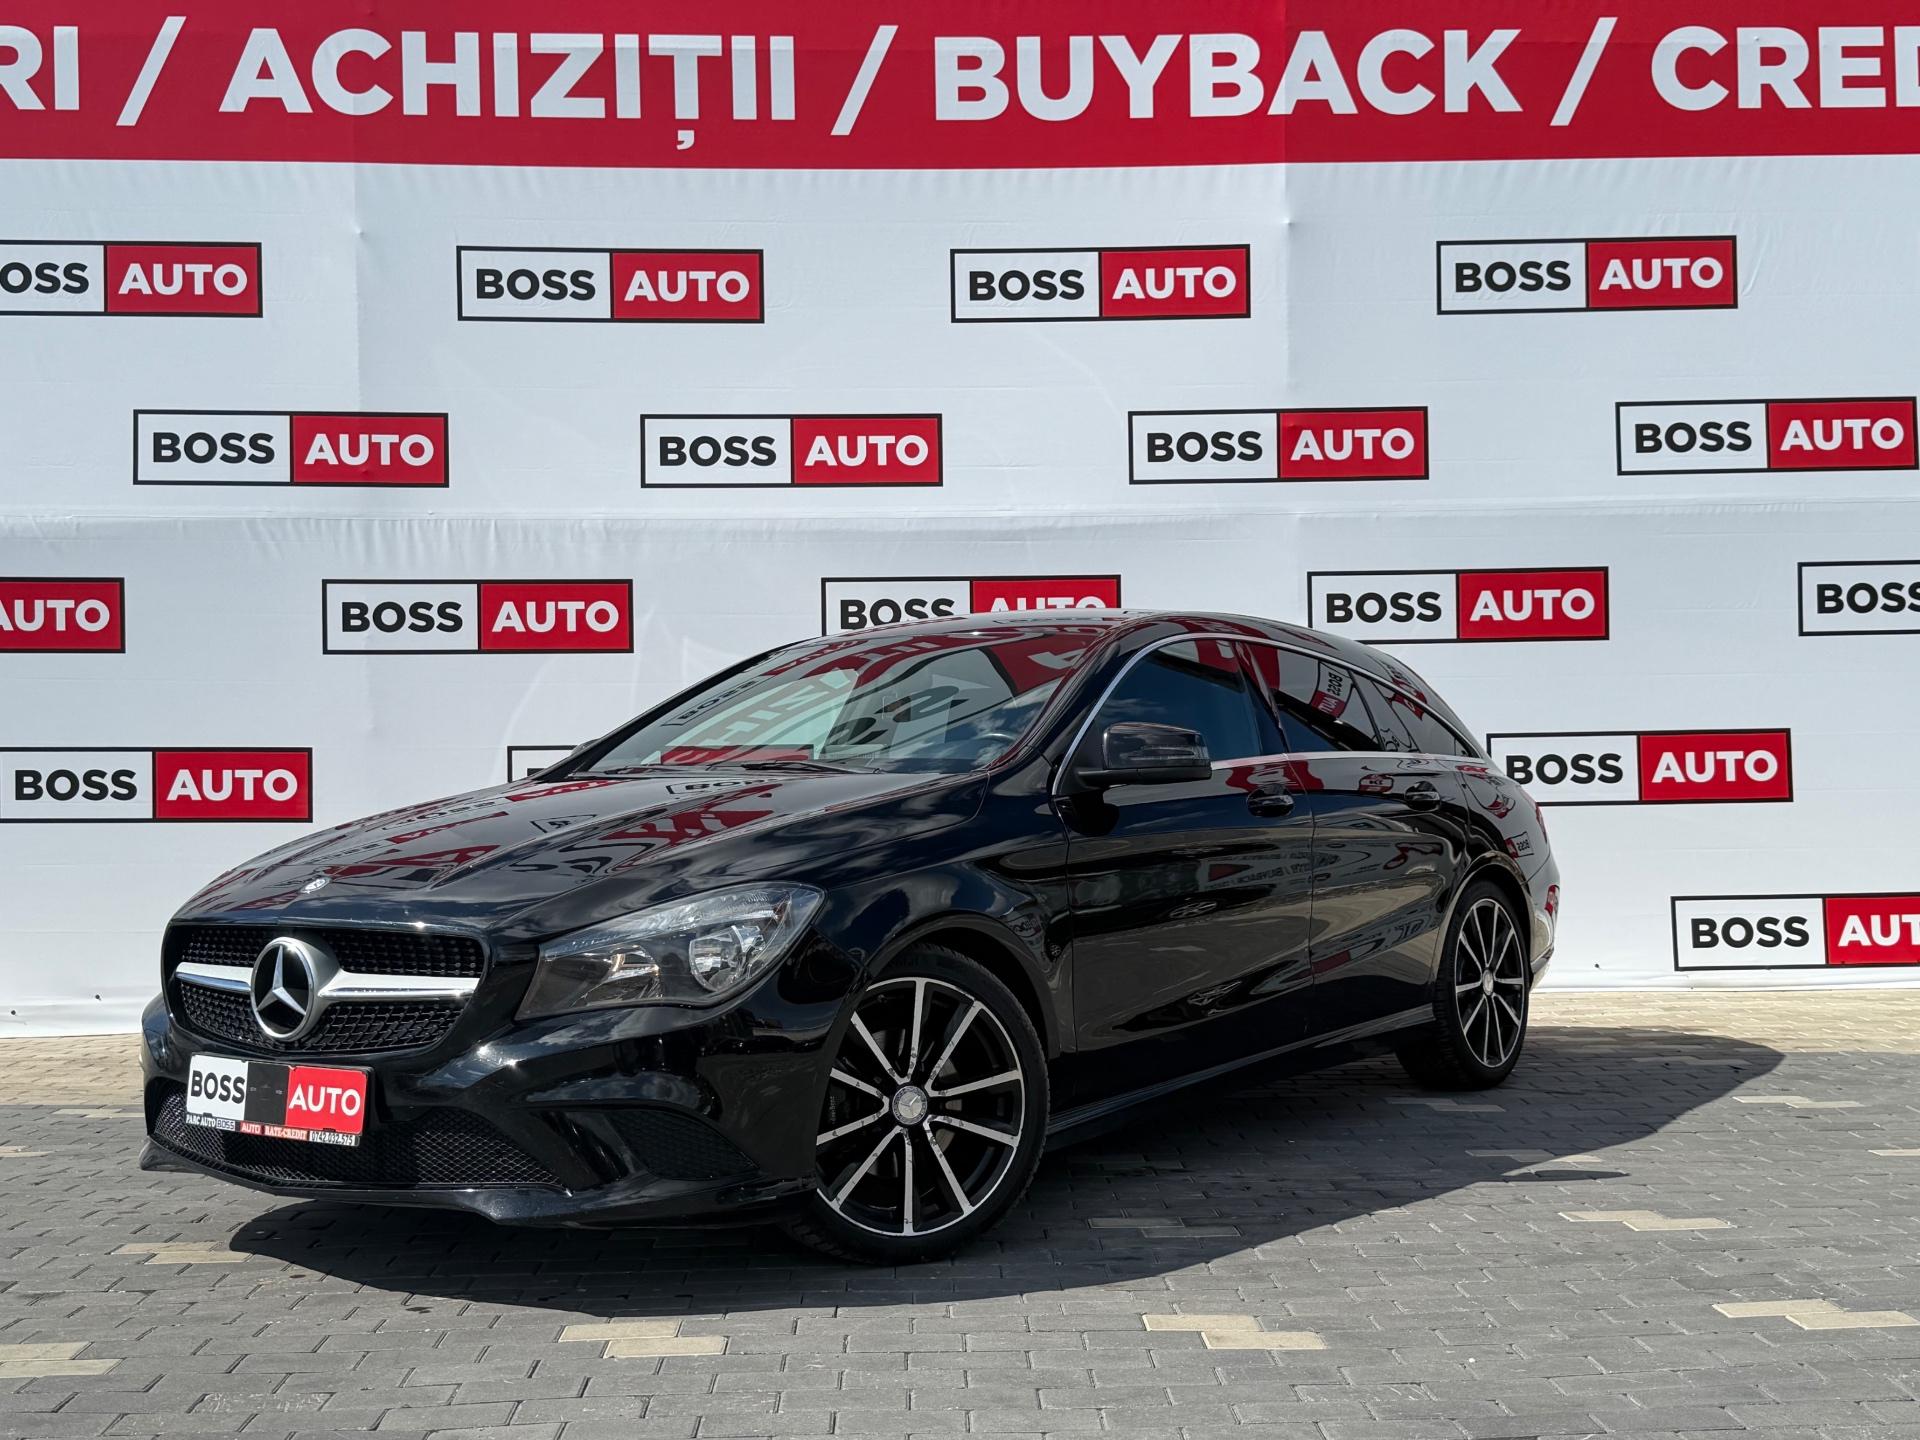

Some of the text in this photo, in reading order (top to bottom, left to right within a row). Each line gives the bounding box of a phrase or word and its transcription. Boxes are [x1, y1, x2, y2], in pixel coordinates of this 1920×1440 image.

[116, 16, 187, 127] /
[831, 25, 899, 136] /
[935, 29, 1523, 122] BUYBACK
[1551, 17, 1618, 127] /
[0, 262, 248, 296] OSS AUTO
[477, 269, 750, 303] BOSS AUTO
[969, 267, 1237, 301] BOSS AUTO
[1456, 257, 1724, 293] BOSS AUTO
[154, 432, 435, 467] BOSS AUTO
[660, 435, 929, 467] BOSS AUTO
[1148, 428, 1415, 463] BOSS AUTO
[1635, 418, 1905, 454] BOSS AUTO
[342, 601, 619, 633] BOSS AUTO
[1327, 589, 1595, 624] BOSS AUTO
[1506, 750, 1778, 785] BOSS AUTO
[15, 769, 298, 802] BOSS AUTO
[1692, 914, 1920, 949] BOSS AUT
[190, 1070, 361, 1116] BOSS AUTO
[200, 1116, 216, 1127] AUTO
[216, 1119, 236, 1130] BOSS
[241, 1122, 261, 1133] AUTO
